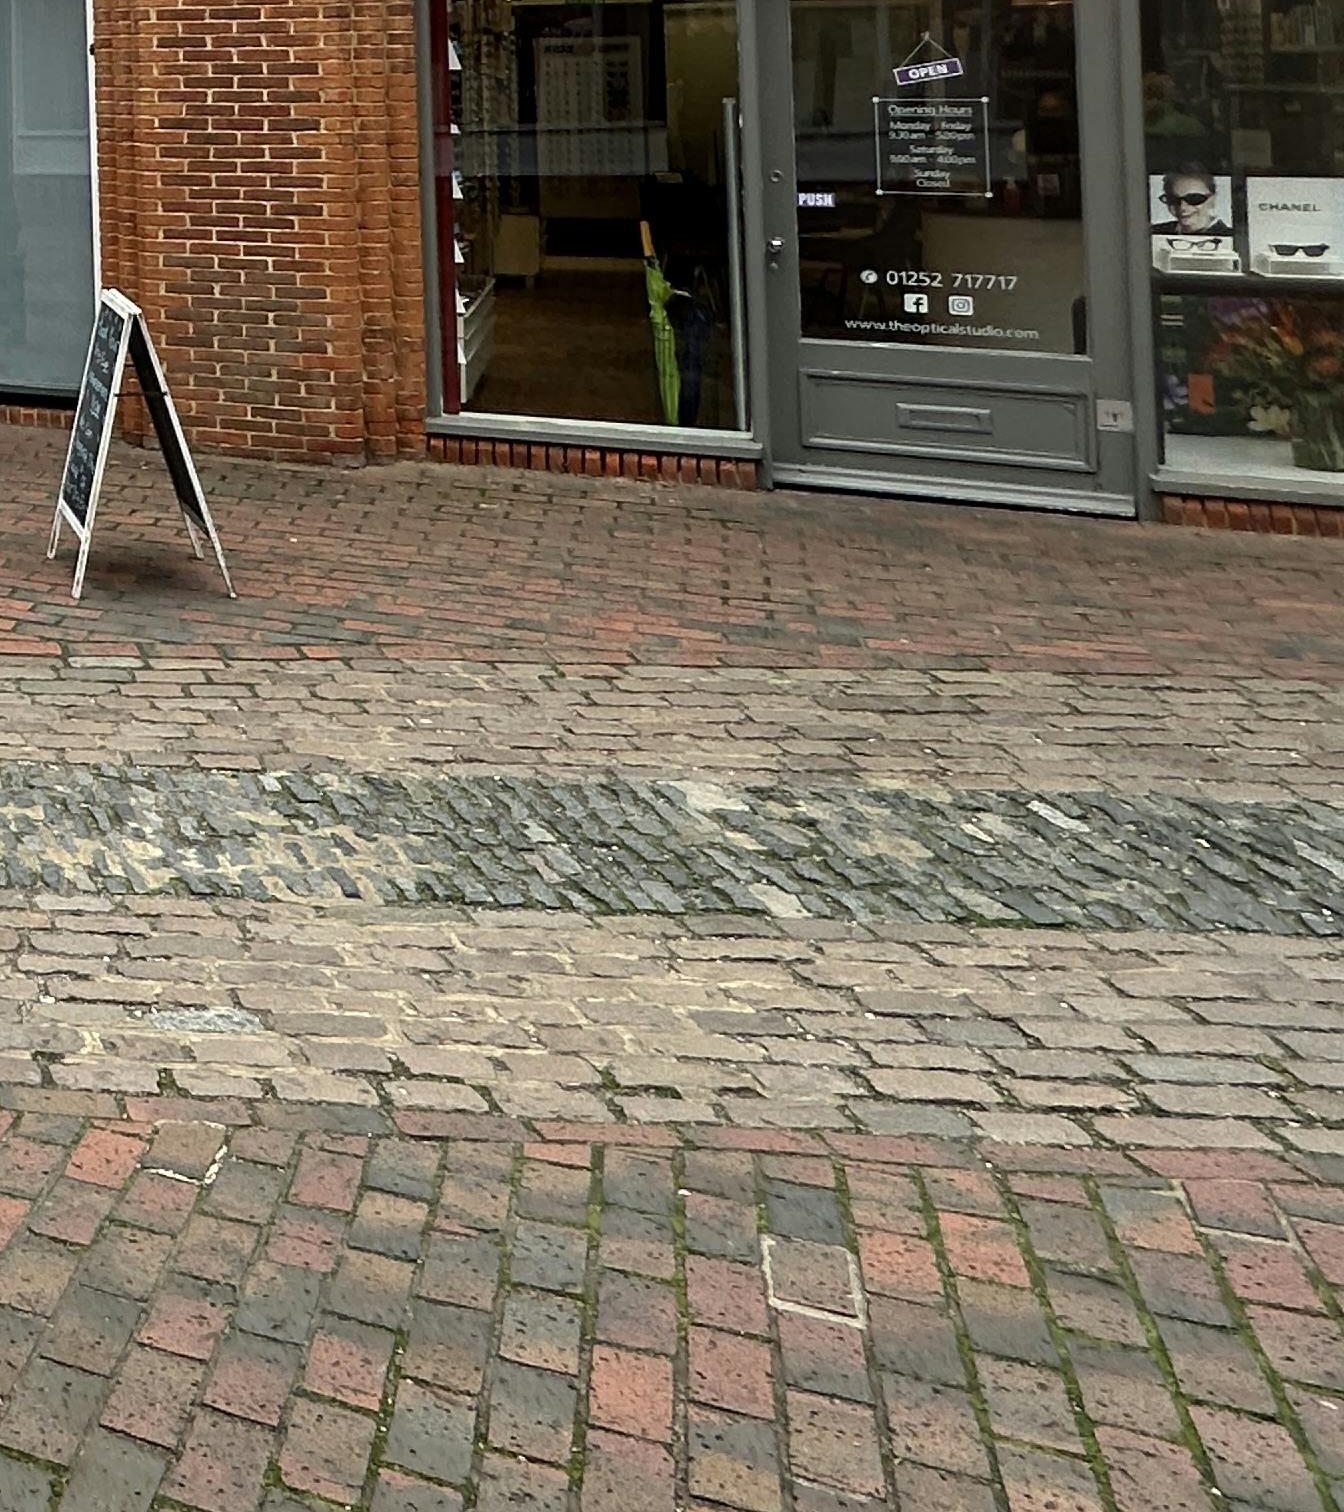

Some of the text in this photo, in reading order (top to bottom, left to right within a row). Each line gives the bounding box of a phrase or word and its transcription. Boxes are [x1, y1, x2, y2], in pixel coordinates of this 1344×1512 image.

[908, 63, 948, 79] OPEN
[798, 192, 836, 207] PUSH
[1258, 202, 1321, 213] CHANEL
[885, 270, 1019, 291] 01252 717717
[844, 319, 1040, 340] www.theopticalstudio.com
